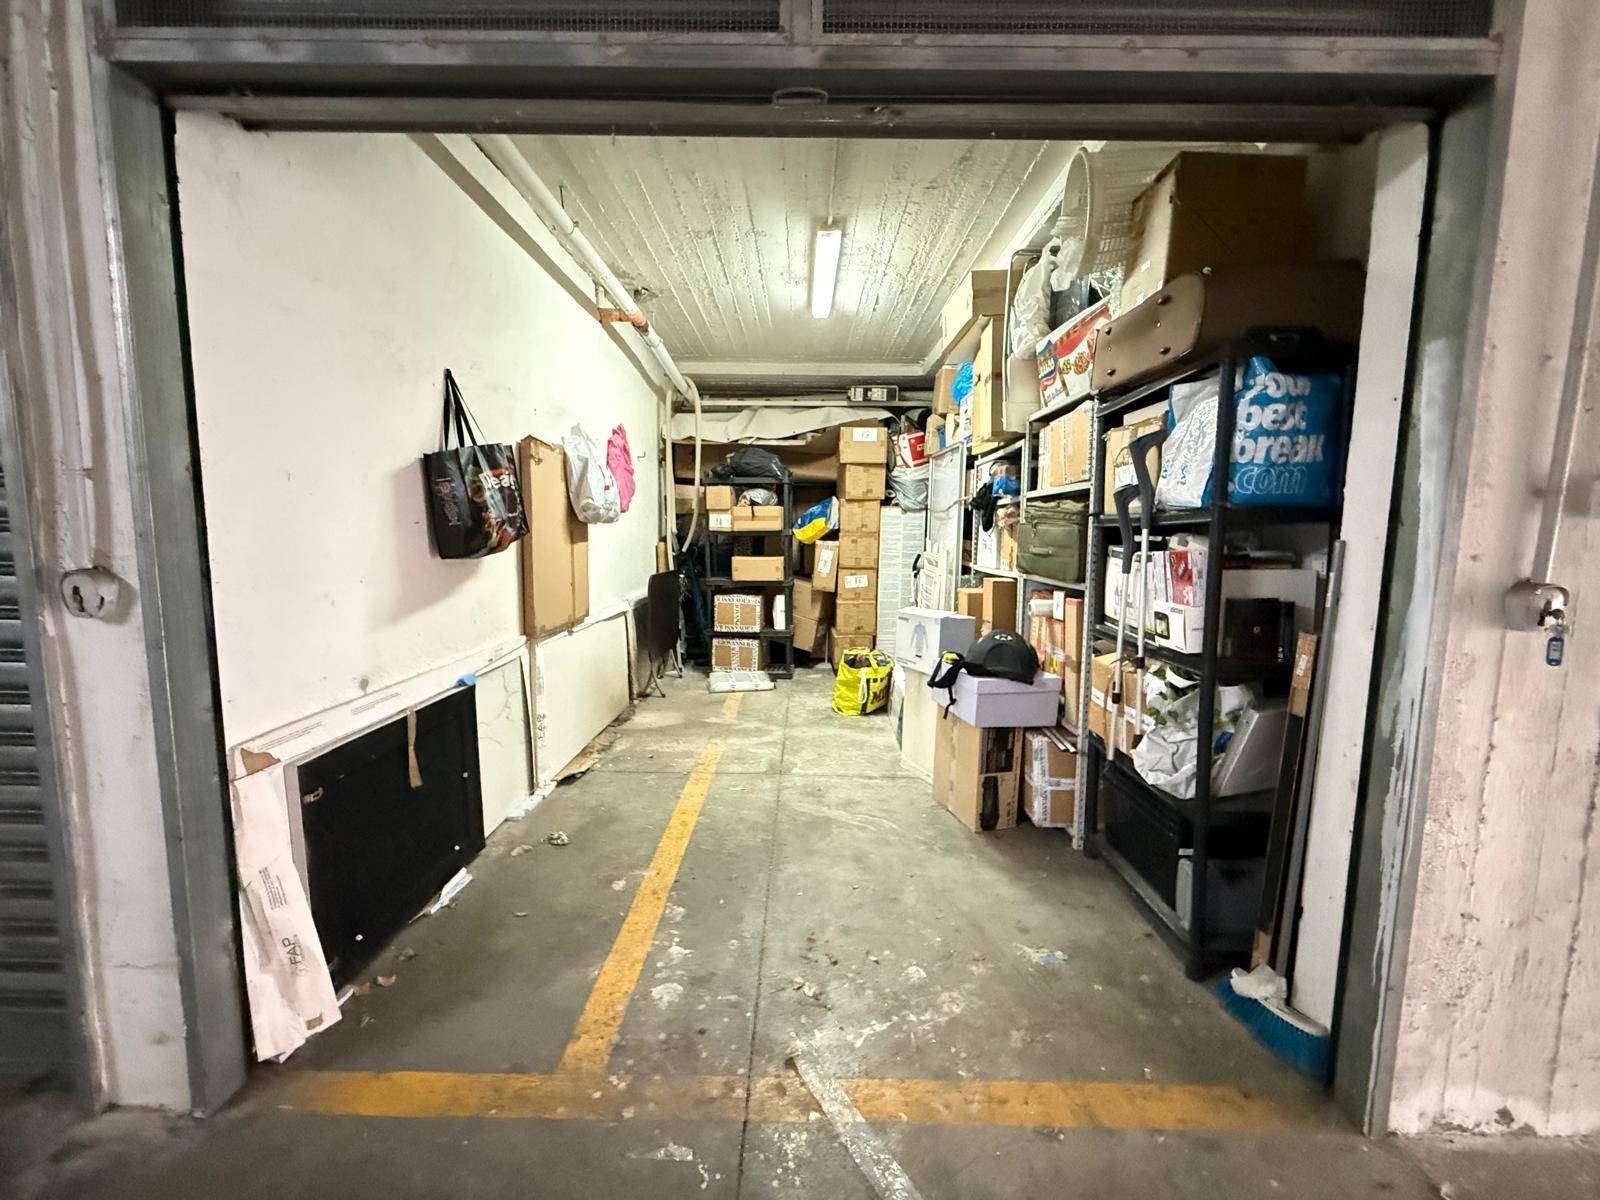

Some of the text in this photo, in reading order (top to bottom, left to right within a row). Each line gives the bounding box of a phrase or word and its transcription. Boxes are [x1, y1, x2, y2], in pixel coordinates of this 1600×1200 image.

[1236, 399, 1307, 430] best
[1231, 432, 1324, 464] break
[282, 937, 302, 966] FAP
